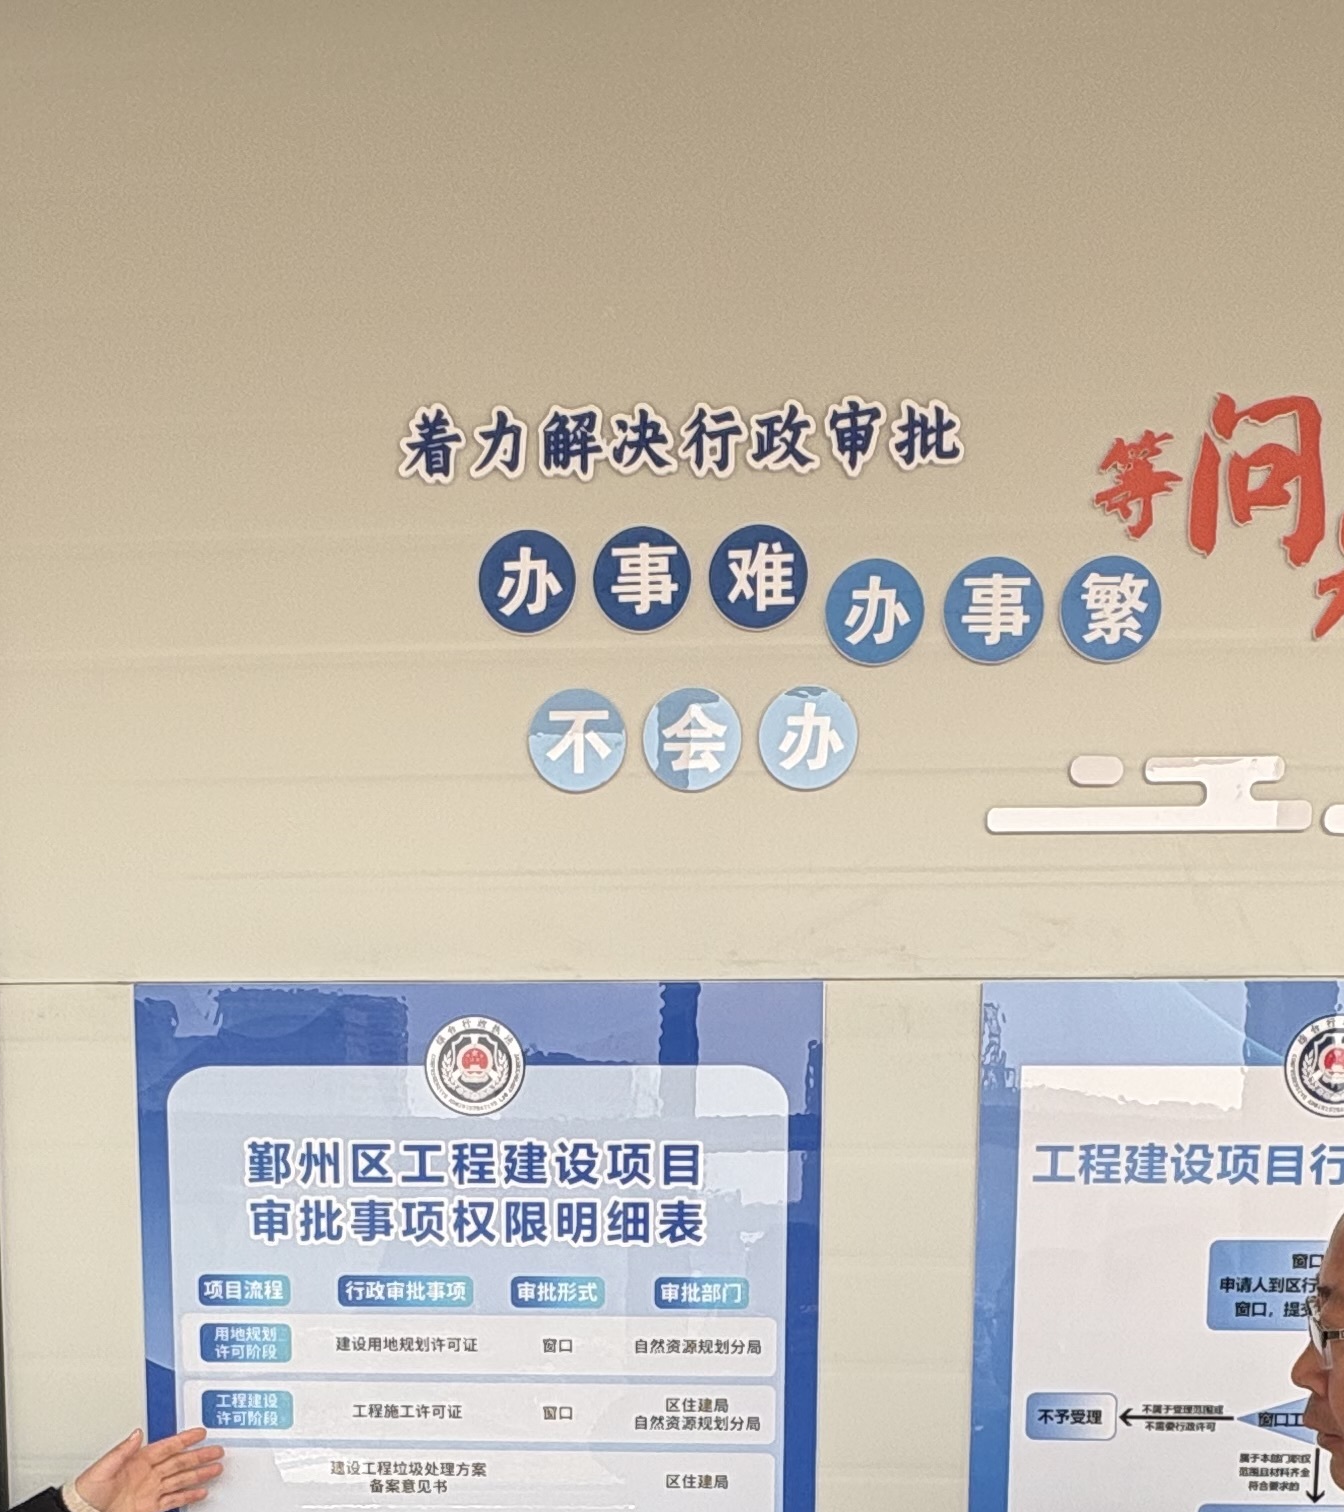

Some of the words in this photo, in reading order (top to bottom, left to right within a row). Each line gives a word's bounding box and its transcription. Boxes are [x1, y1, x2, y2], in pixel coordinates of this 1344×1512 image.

[403, 398, 961, 478] 着力解决行政审批
[494, 537, 798, 620] 办事难
[843, 570, 1152, 647] 办事繁
[543, 700, 847, 774] 不会办
[246, 1140, 704, 1188] 鄞州区工程建设项目
[250, 1200, 706, 1246] 审批事项权限明细表
[204, 1280, 284, 1300] 项目流程
[345, 1281, 466, 1301] 行政审批事项
[517, 1282, 597, 1302] 审批形式
[660, 1283, 742, 1303] 审批部门
[214, 1327, 277, 1342] 用地规划
[214, 1344, 278, 1360] 许可阶段
[335, 1336, 479, 1353] 建设用地规划许可证
[542, 1338, 573, 1354] 窗口
[634, 1338, 762, 1355] 自然资源规划分局
[216, 1394, 278, 1409] 工程建设
[665, 1397, 729, 1413] 区住建局
[216, 1411, 279, 1427] 许可阶段
[352, 1404, 463, 1420] 工程施工许可证
[1037, 1408, 1103, 1426] 不予受理
[634, 1415, 761, 1432] 自然资源规划分局
[330, 1460, 488, 1477] 建设工程垃圾处理方案
[369, 1479, 448, 1494] 备案意见书
[665, 1474, 729, 1490] 区住建局
